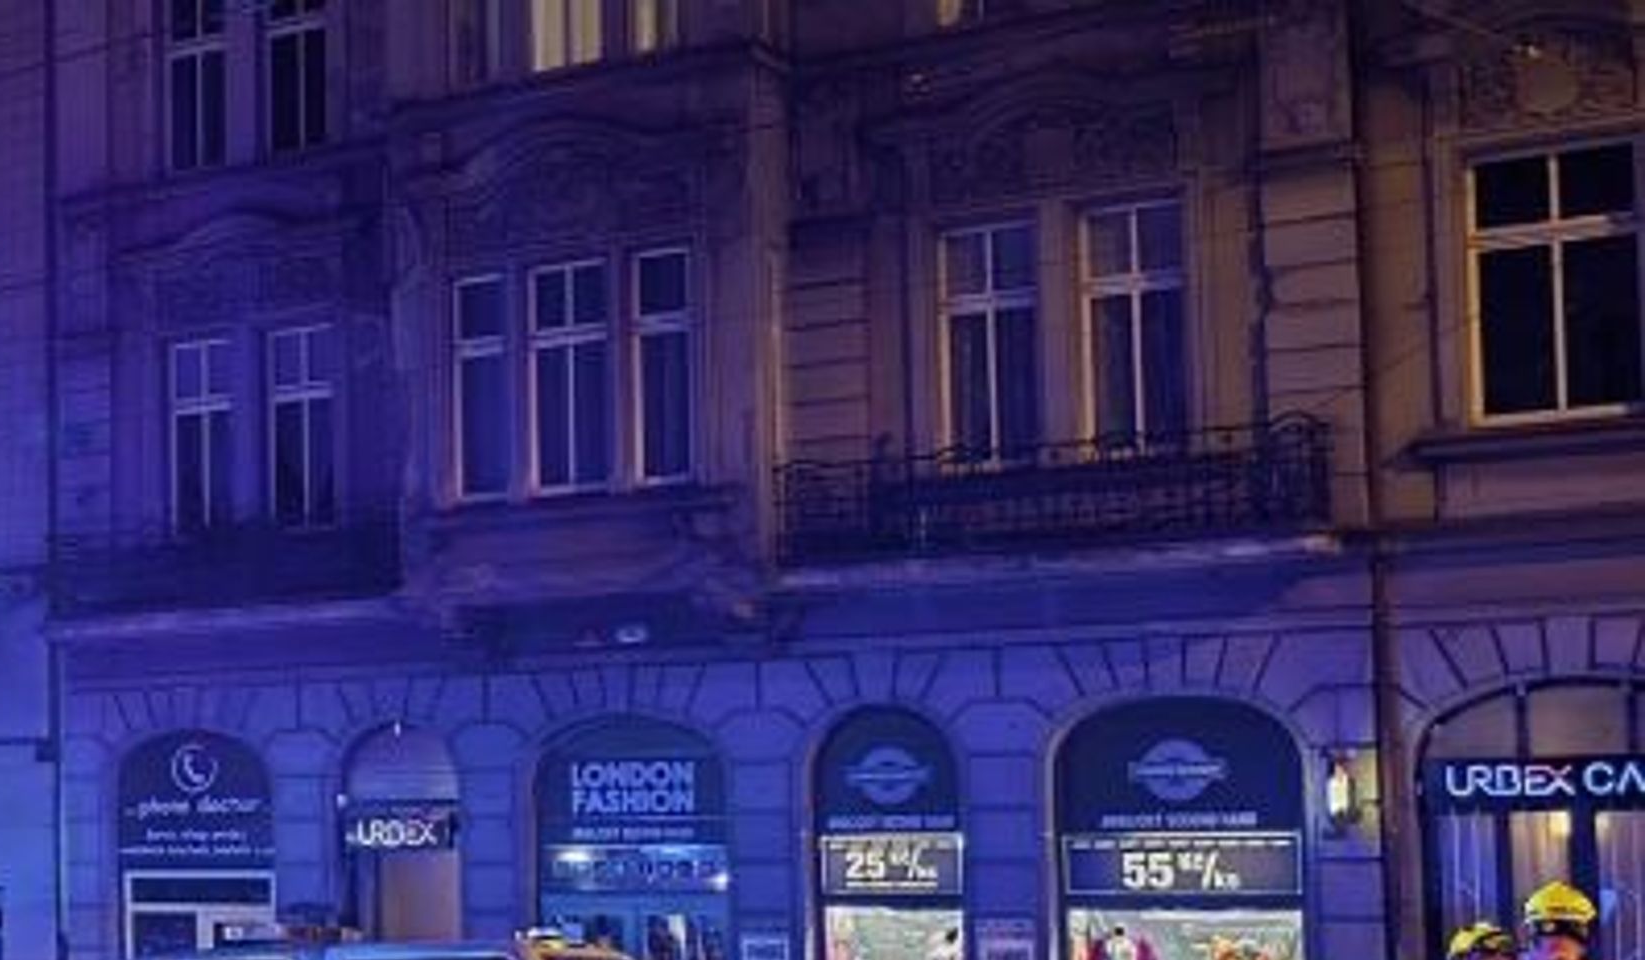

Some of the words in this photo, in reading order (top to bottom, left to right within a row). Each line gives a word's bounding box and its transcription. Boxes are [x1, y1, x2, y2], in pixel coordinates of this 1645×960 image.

[572, 762, 695, 788] LONDON
[1446, 764, 1575, 796] URBEX
[572, 790, 695, 813] FASHION
[844, 850, 886, 879] 25
[1121, 851, 1175, 888] 55
